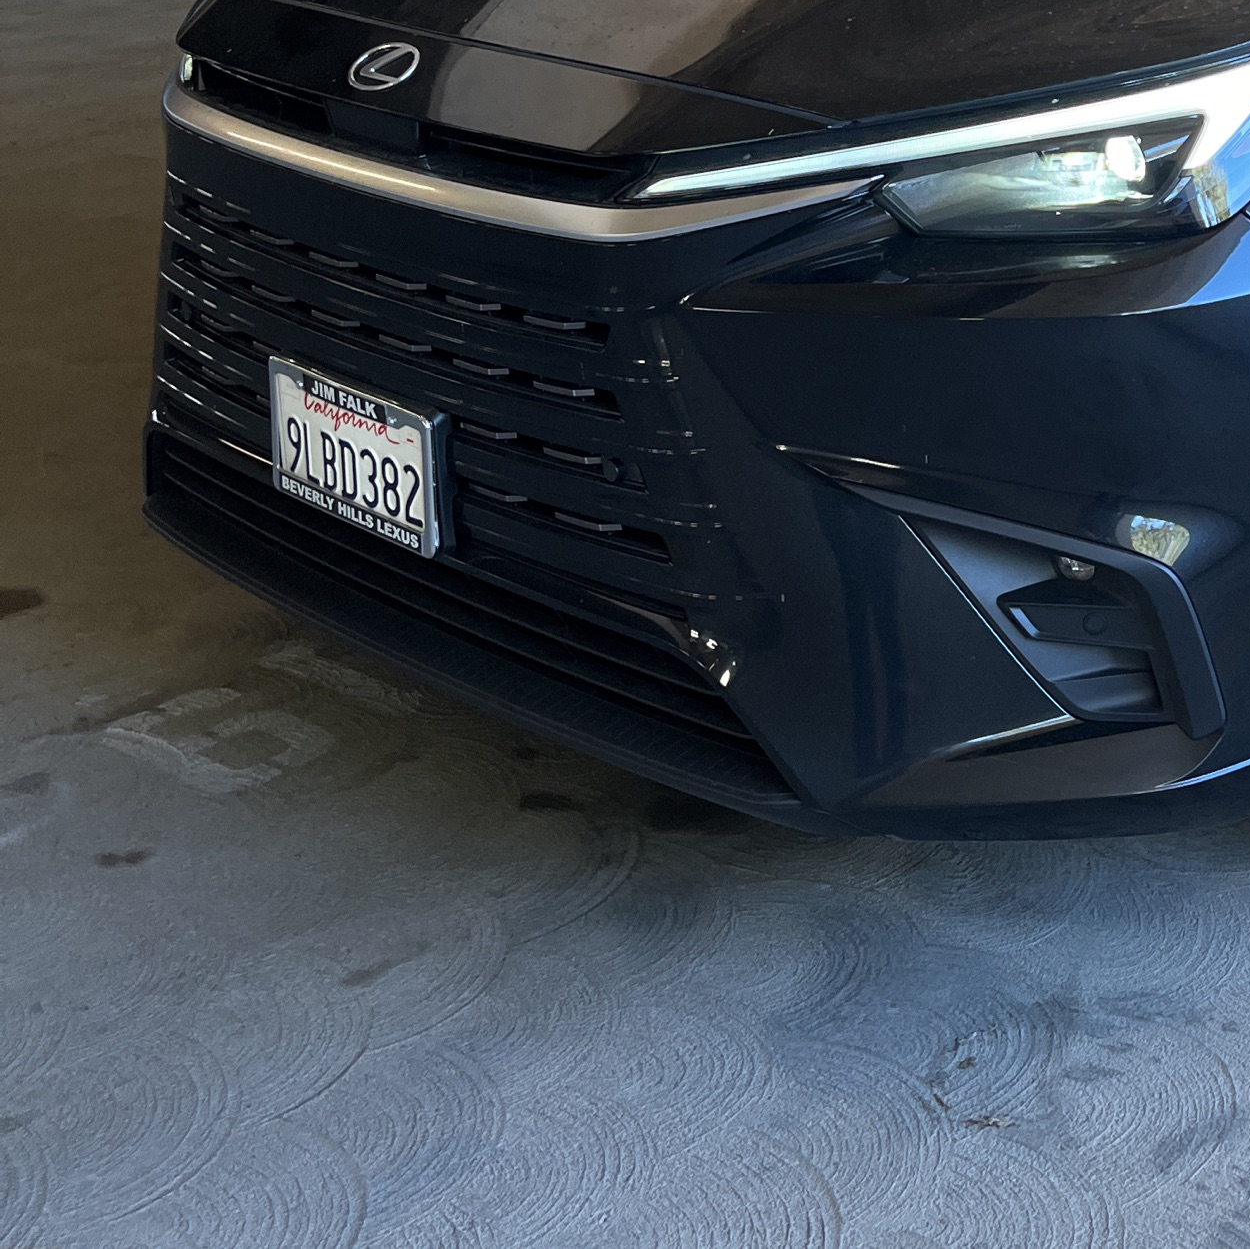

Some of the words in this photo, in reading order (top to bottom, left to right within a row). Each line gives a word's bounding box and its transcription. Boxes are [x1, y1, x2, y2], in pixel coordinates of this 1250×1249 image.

[311, 380, 336, 403] JIM
[339, 392, 378, 419] FALK
[287, 416, 424, 528] 9LBD382
[281, 475, 335, 511] BEVERLY
[337, 498, 374, 528] HILLS
[377, 518, 420, 549] LEXUS
